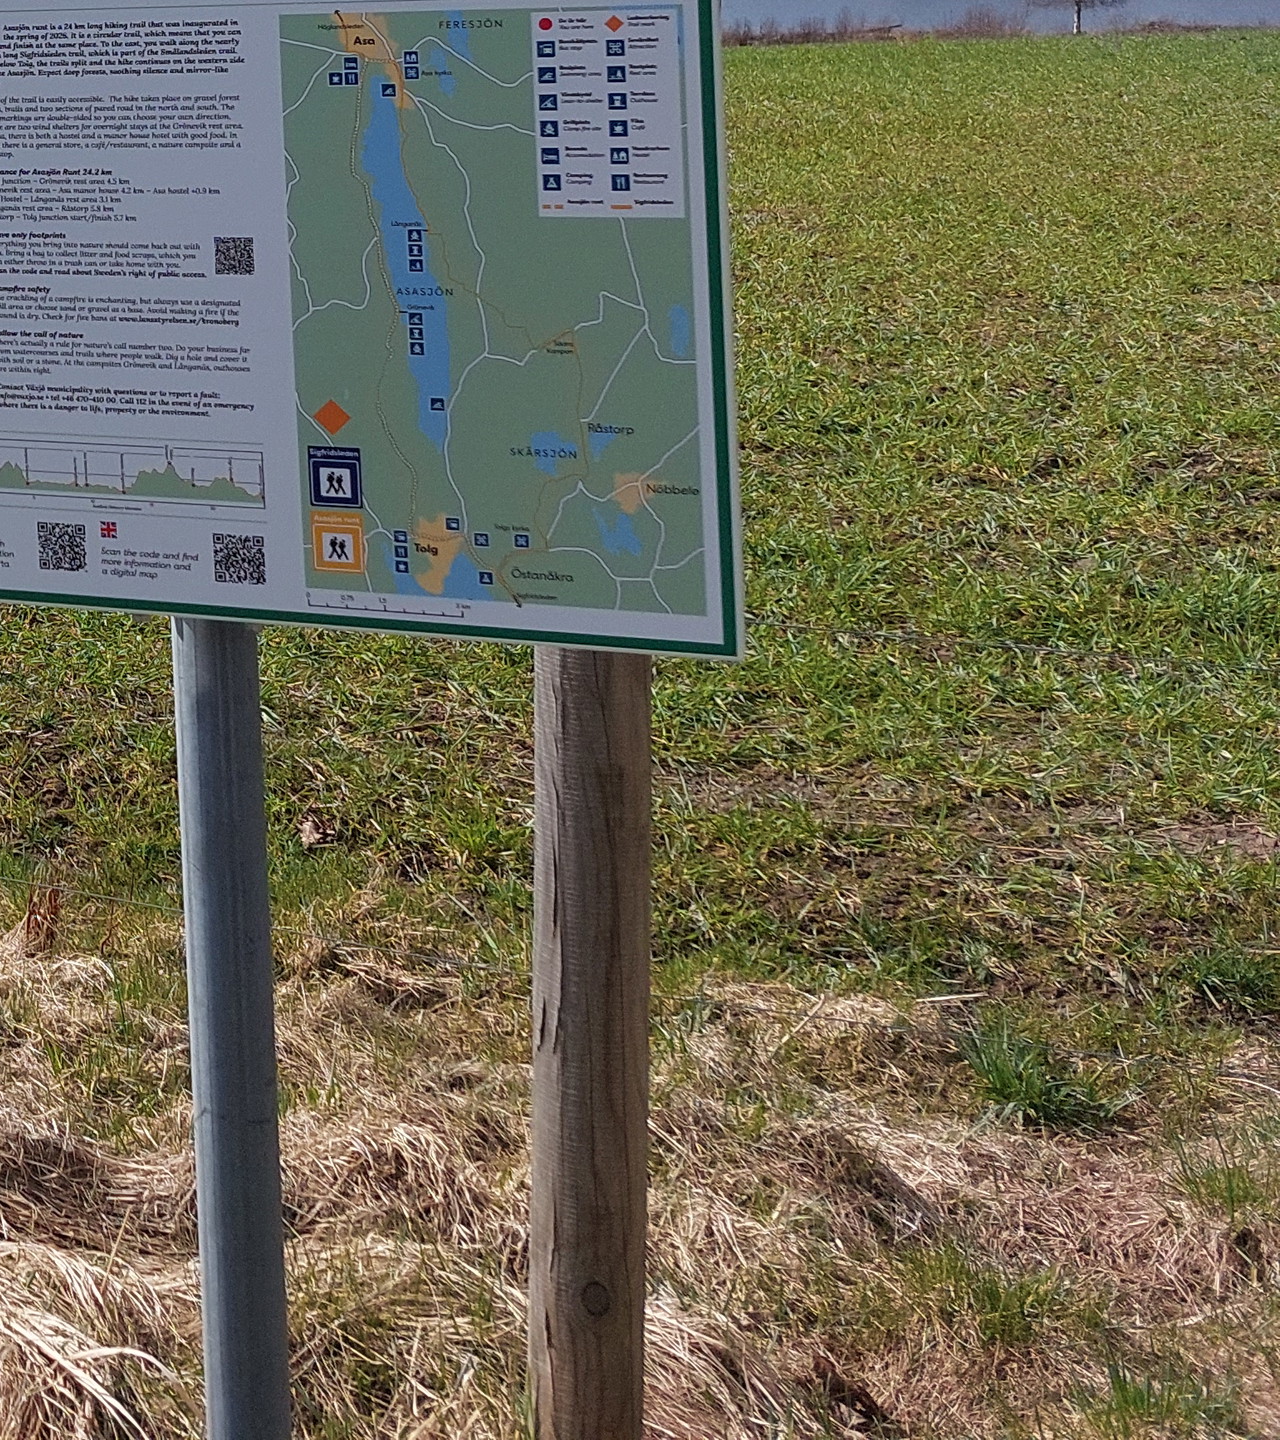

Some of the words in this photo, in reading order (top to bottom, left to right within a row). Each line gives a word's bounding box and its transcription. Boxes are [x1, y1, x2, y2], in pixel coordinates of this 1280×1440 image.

[438, 17, 503, 30] FERESJÖN
[352, 34, 377, 46] Asa
[395, 285, 454, 297] ASASJÖN
[587, 422, 635, 436] Råstorp
[509, 446, 578, 460] SKÄRSJÖN
[646, 483, 700, 496] Nöbbele
[413, 542, 439, 557] Tolg
[510, 566, 575, 583] Östanåkra
